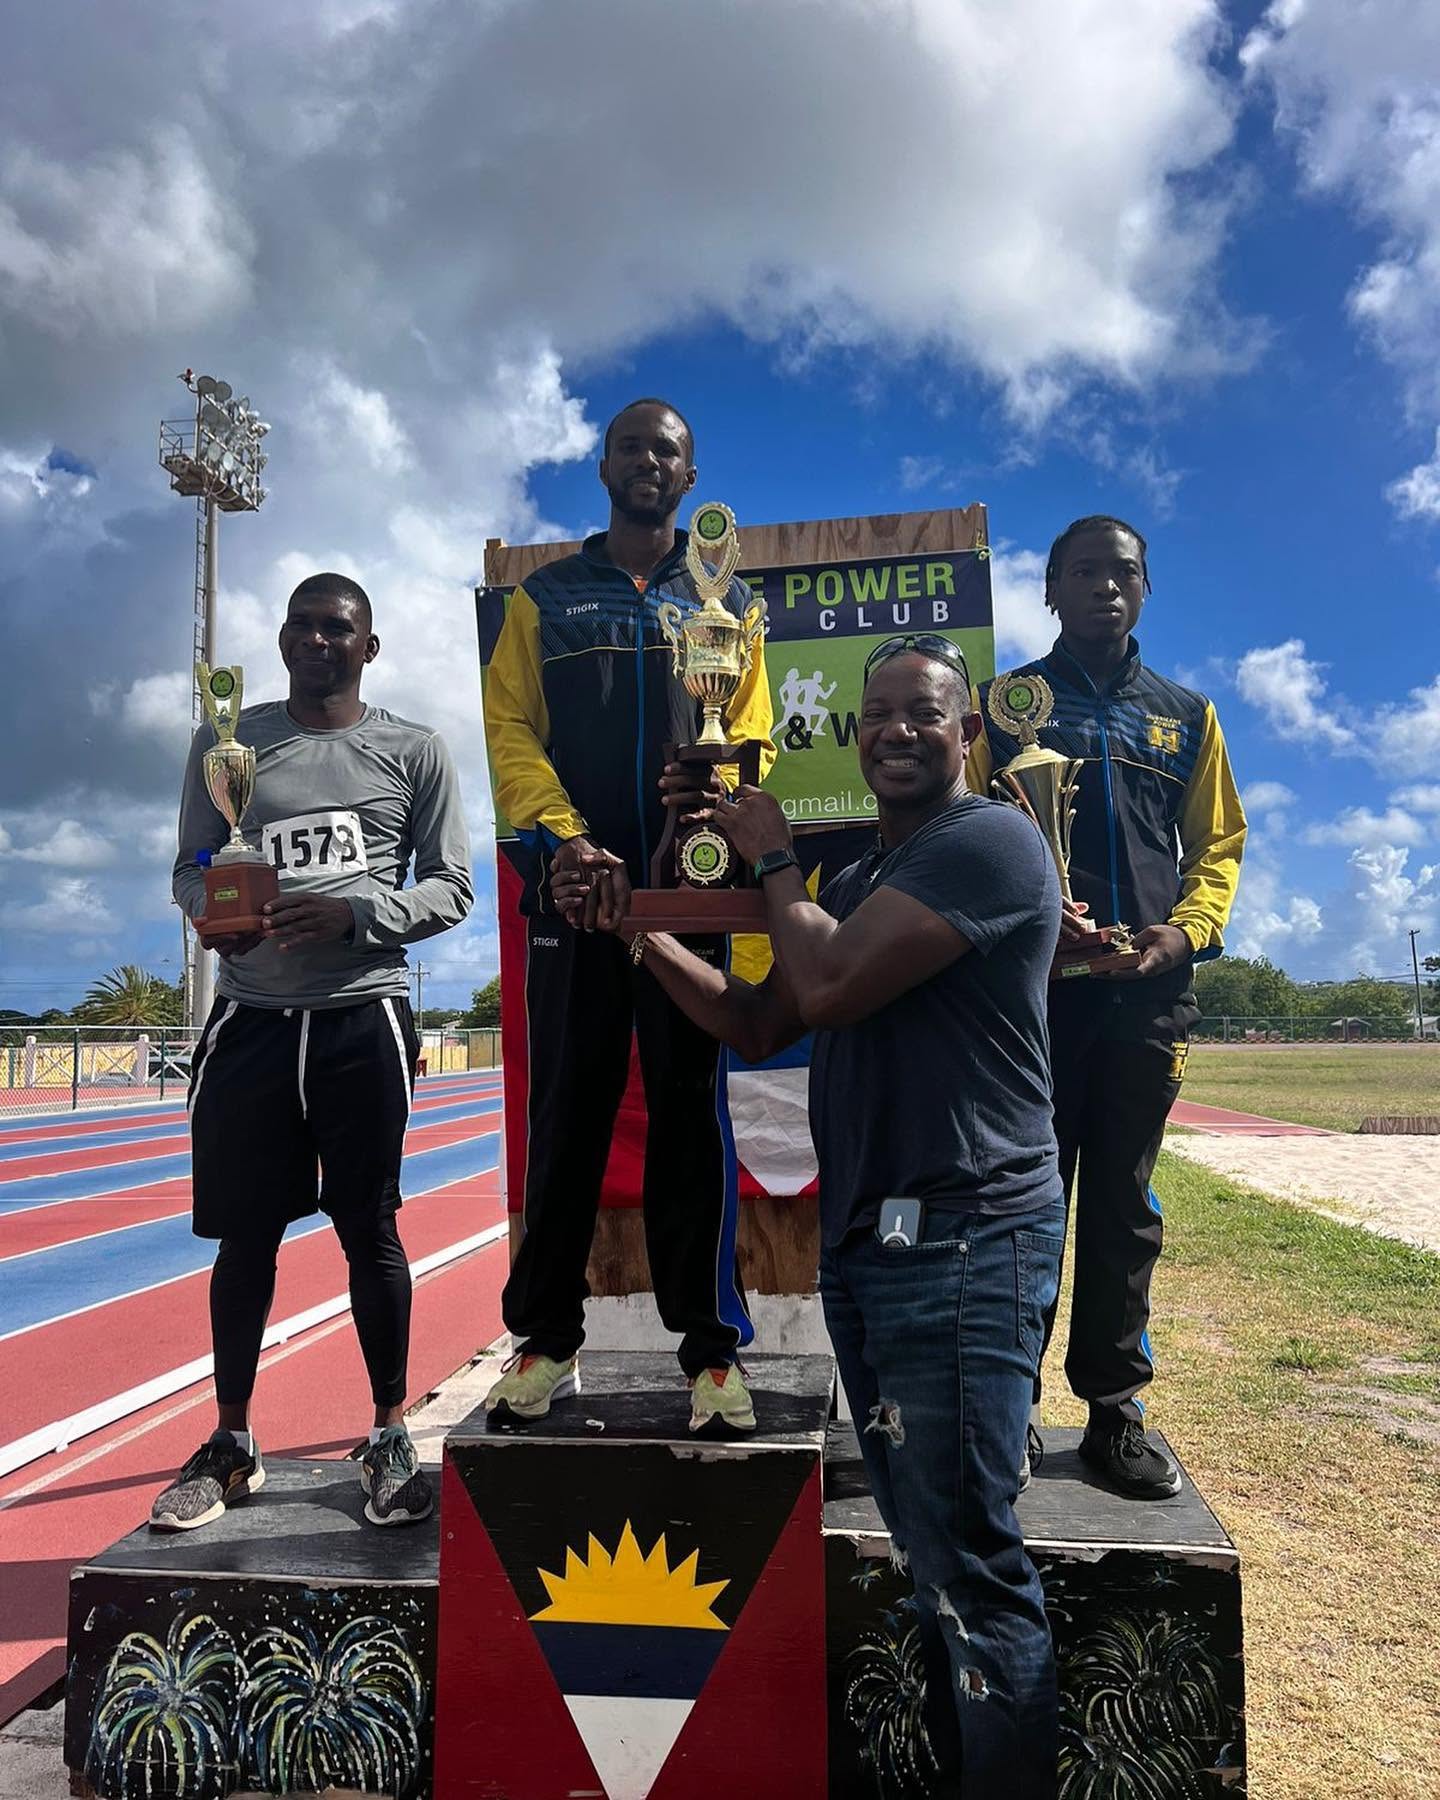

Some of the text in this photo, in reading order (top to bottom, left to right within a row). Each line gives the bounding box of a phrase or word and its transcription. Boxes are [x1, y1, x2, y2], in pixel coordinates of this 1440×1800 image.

[785, 562, 955, 608] POWER
[565, 602, 600, 616] STIGIX
[819, 600, 949, 630] CLUB
[784, 715, 814, 750] &
[781, 790, 878, 820] gmail.c
[270, 824, 357, 870] 1573
[533, 936, 559, 947] STIGIX
